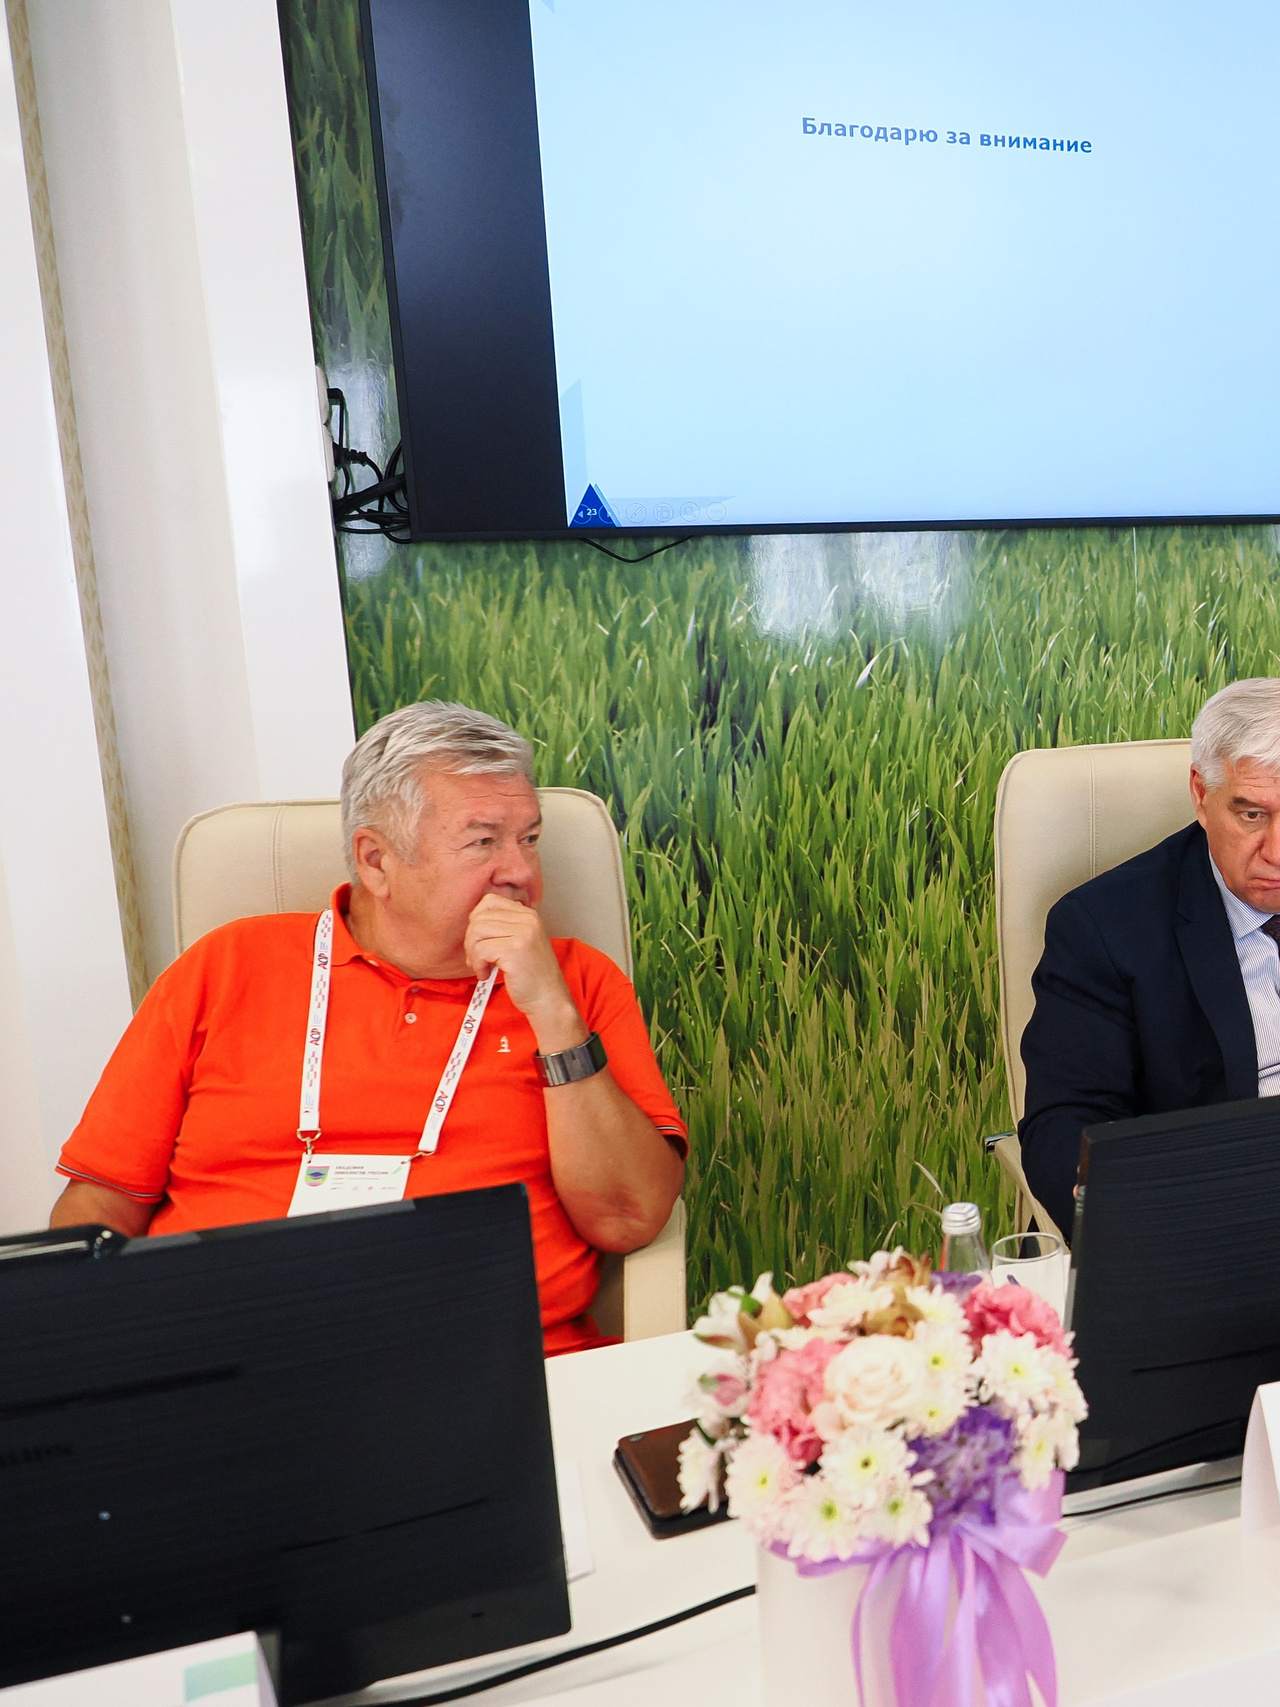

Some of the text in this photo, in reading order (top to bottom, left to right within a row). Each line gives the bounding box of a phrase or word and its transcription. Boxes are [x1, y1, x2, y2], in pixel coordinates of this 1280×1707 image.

[802, 117, 1092, 153] Благодарю за внимание
[587, 508, 597, 516] 23
